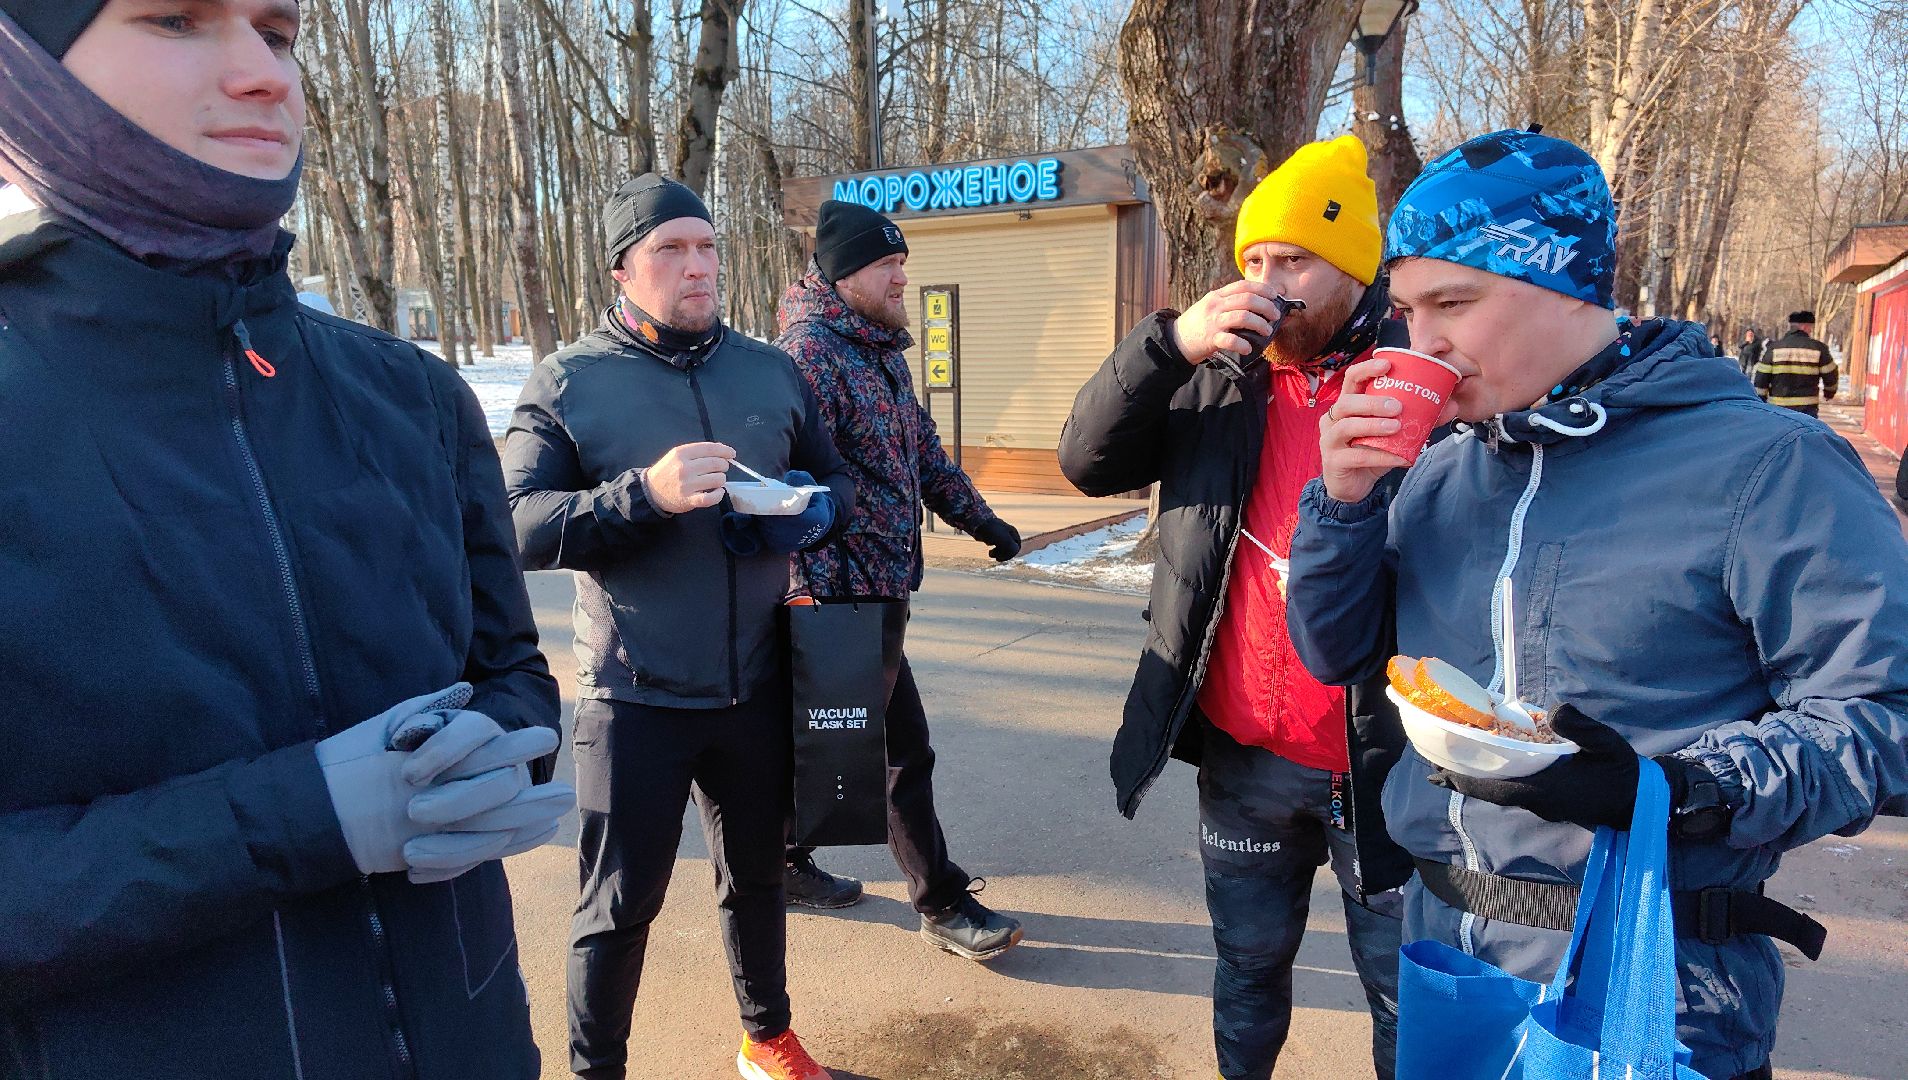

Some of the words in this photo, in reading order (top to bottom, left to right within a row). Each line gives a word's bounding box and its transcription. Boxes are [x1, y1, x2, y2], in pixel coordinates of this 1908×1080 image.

[832, 157, 1059, 213] МОРОЖЕНОЕ
[1477, 221, 1581, 276] RAY
[930, 333, 947, 345] WC
[807, 707, 868, 720] VACUUM
[808, 720, 844, 730] FLASK
[846, 719, 868, 729] SET
[1201, 822, 1281, 853] Relentless
